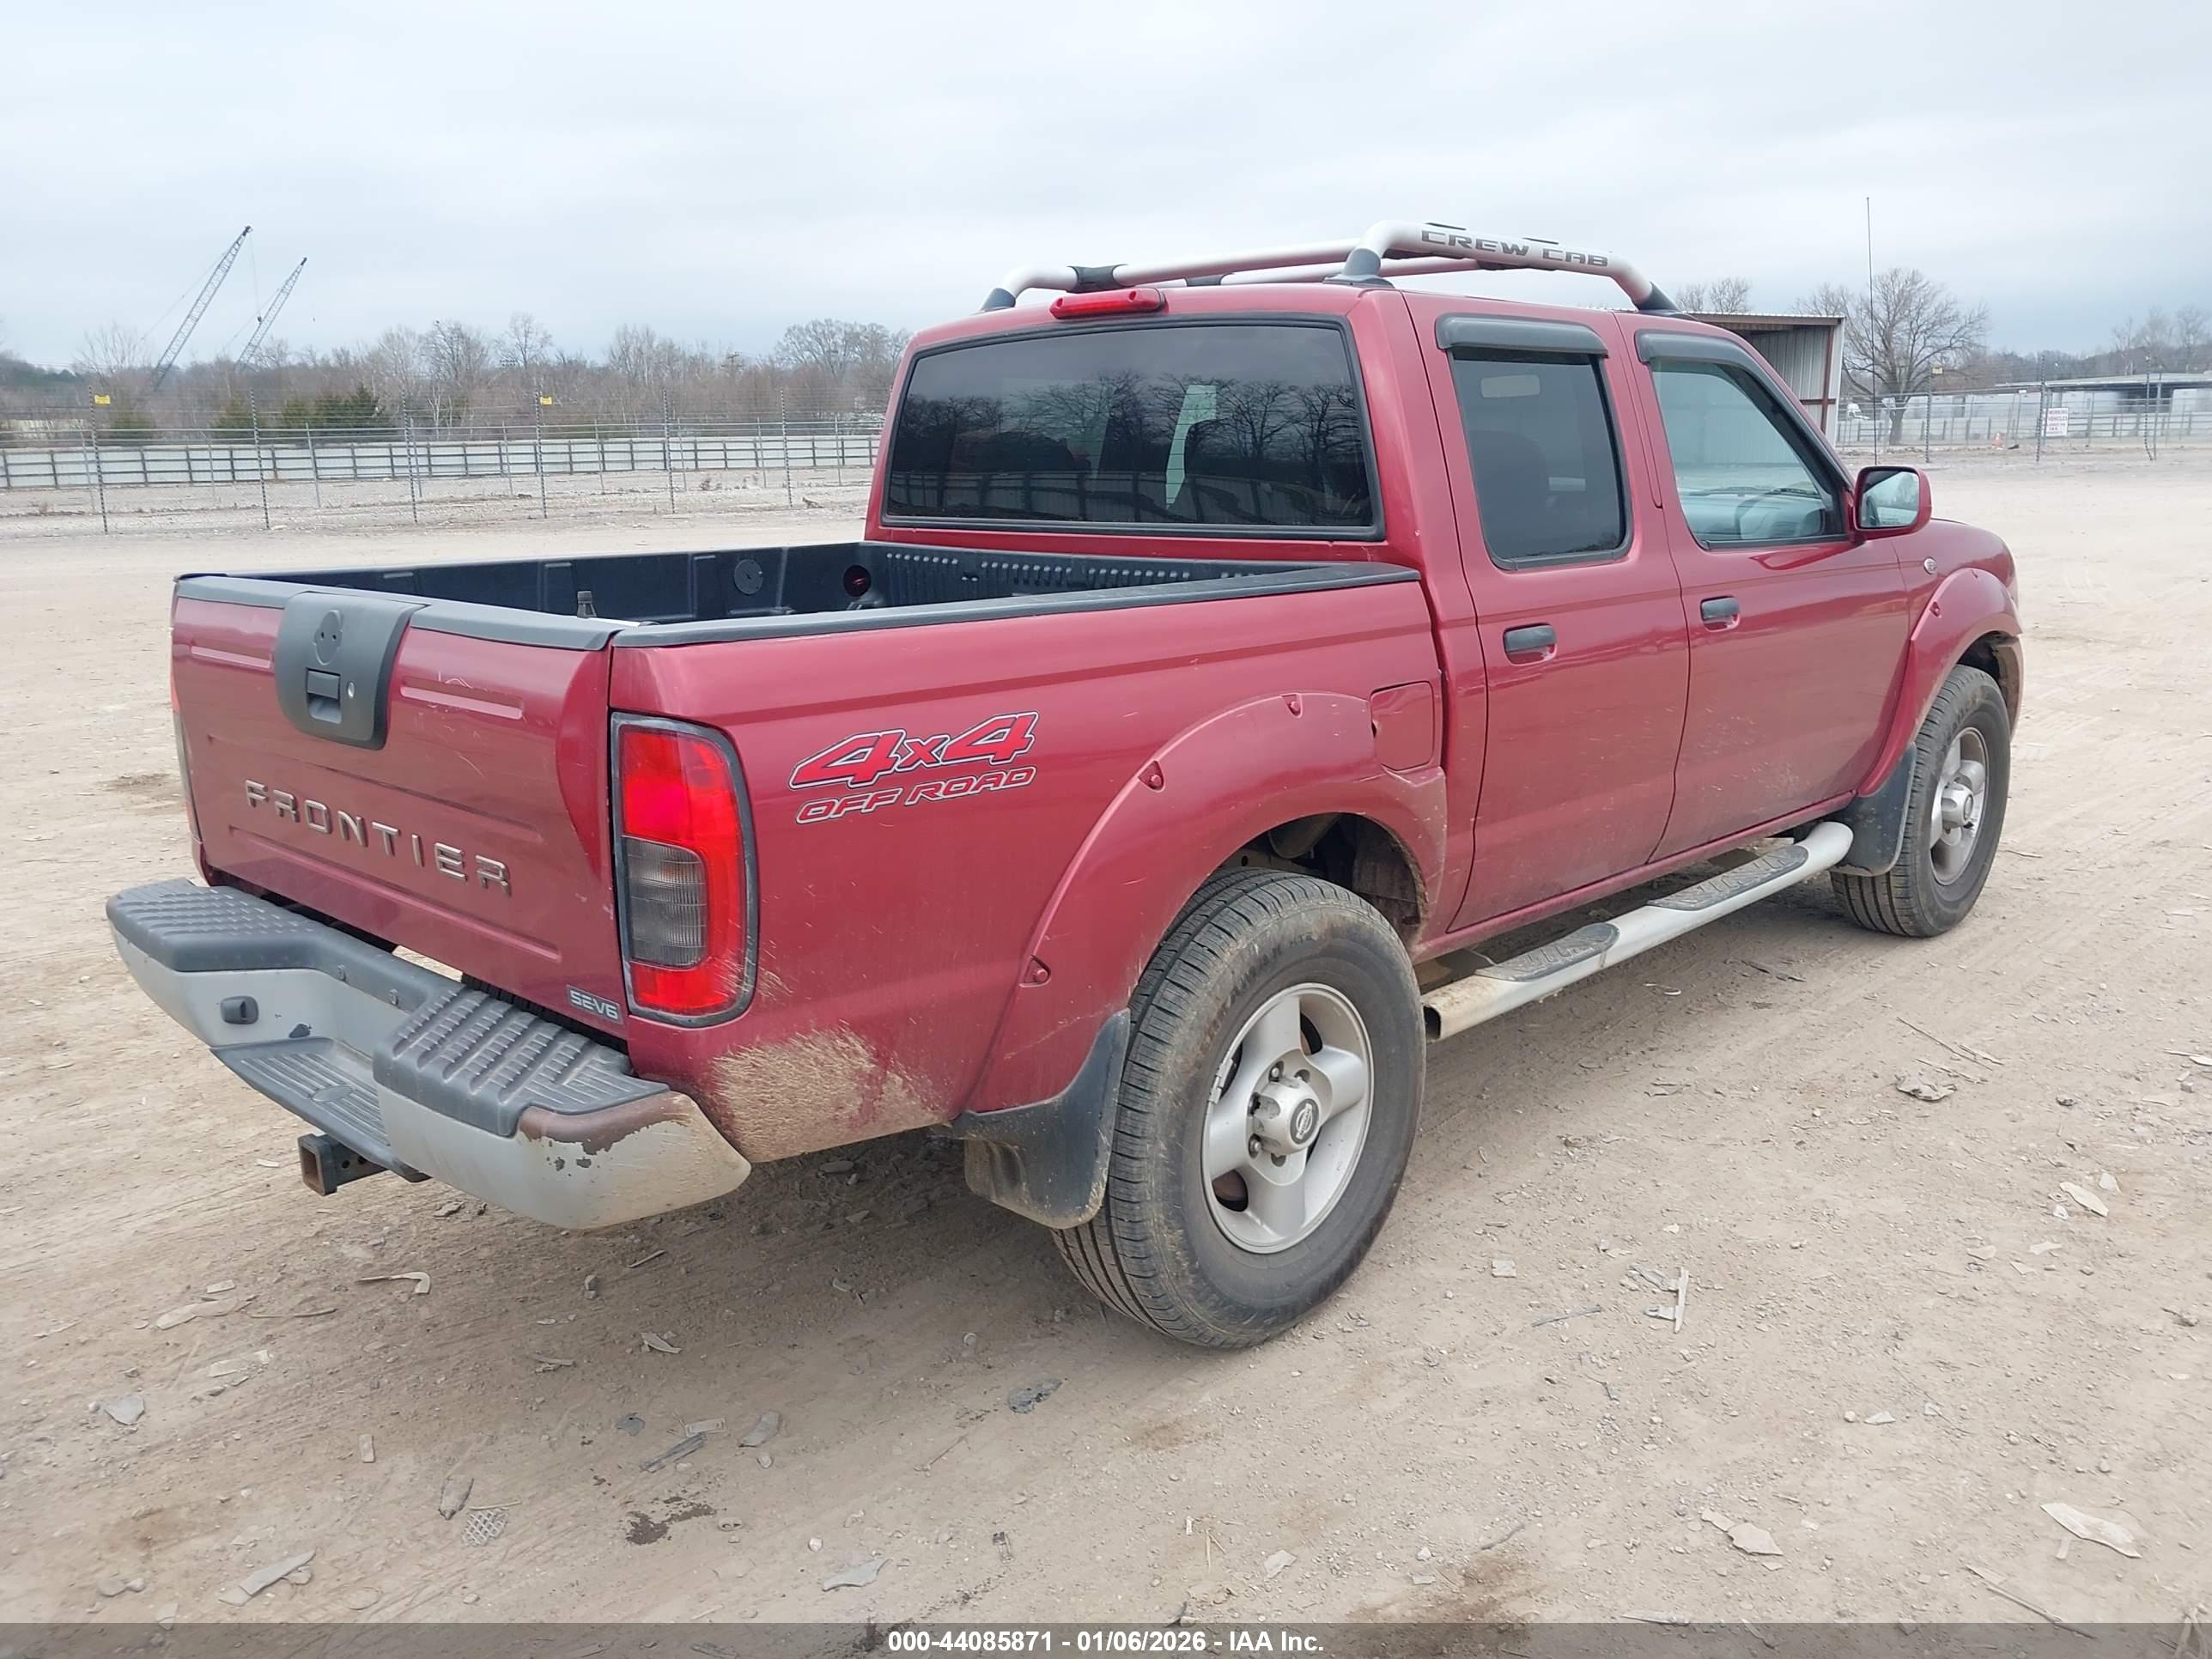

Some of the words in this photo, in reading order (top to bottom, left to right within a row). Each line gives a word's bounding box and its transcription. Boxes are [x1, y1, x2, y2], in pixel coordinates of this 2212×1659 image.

[1421, 229, 1529, 257] CREW
[1542, 246, 1608, 267] CAB
[789, 711, 1039, 790] 4x4
[796, 787, 904, 824] OFF
[903, 766, 1038, 806] ROAD
[245, 778, 512, 896] FRONTIER
